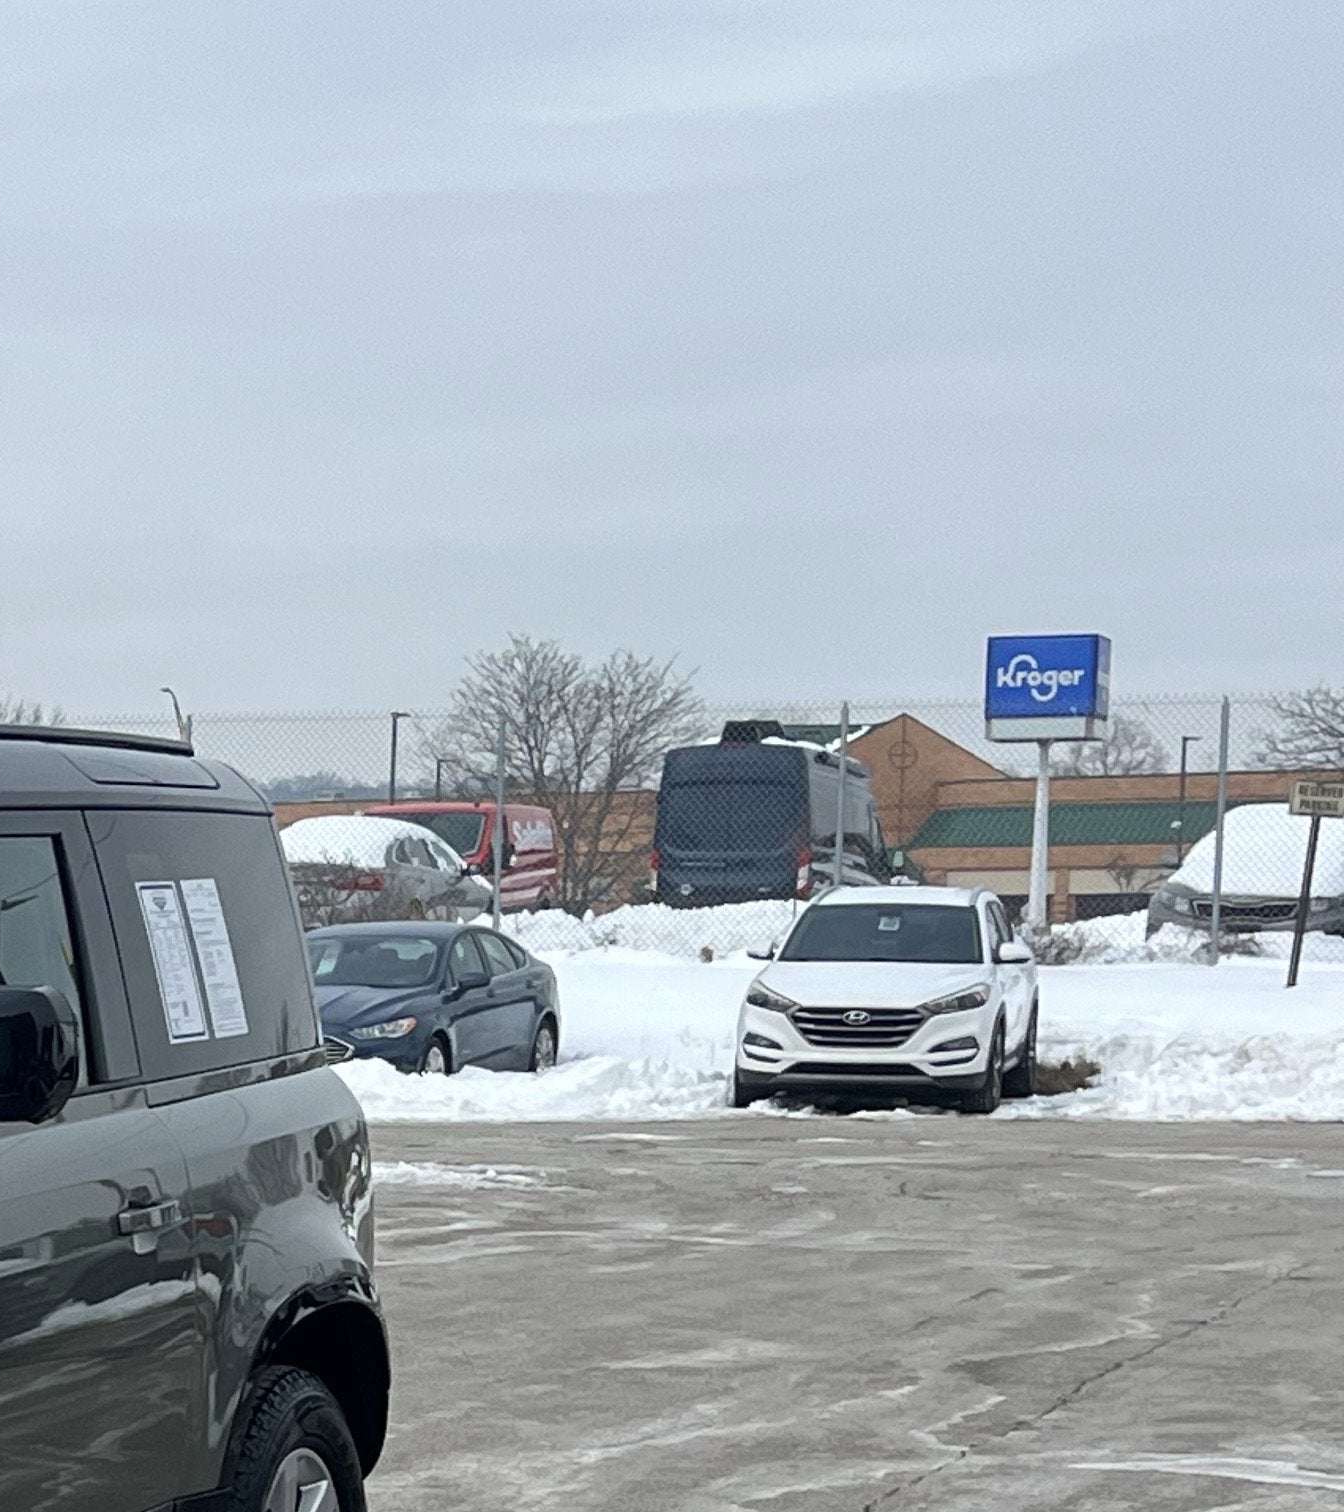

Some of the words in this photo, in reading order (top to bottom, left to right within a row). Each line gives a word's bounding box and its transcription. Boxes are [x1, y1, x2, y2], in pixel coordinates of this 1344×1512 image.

[996, 654, 1084, 702] Kroger
[1298, 784, 1343, 799] RESERVED
[1299, 799, 1339, 812] PARKING
